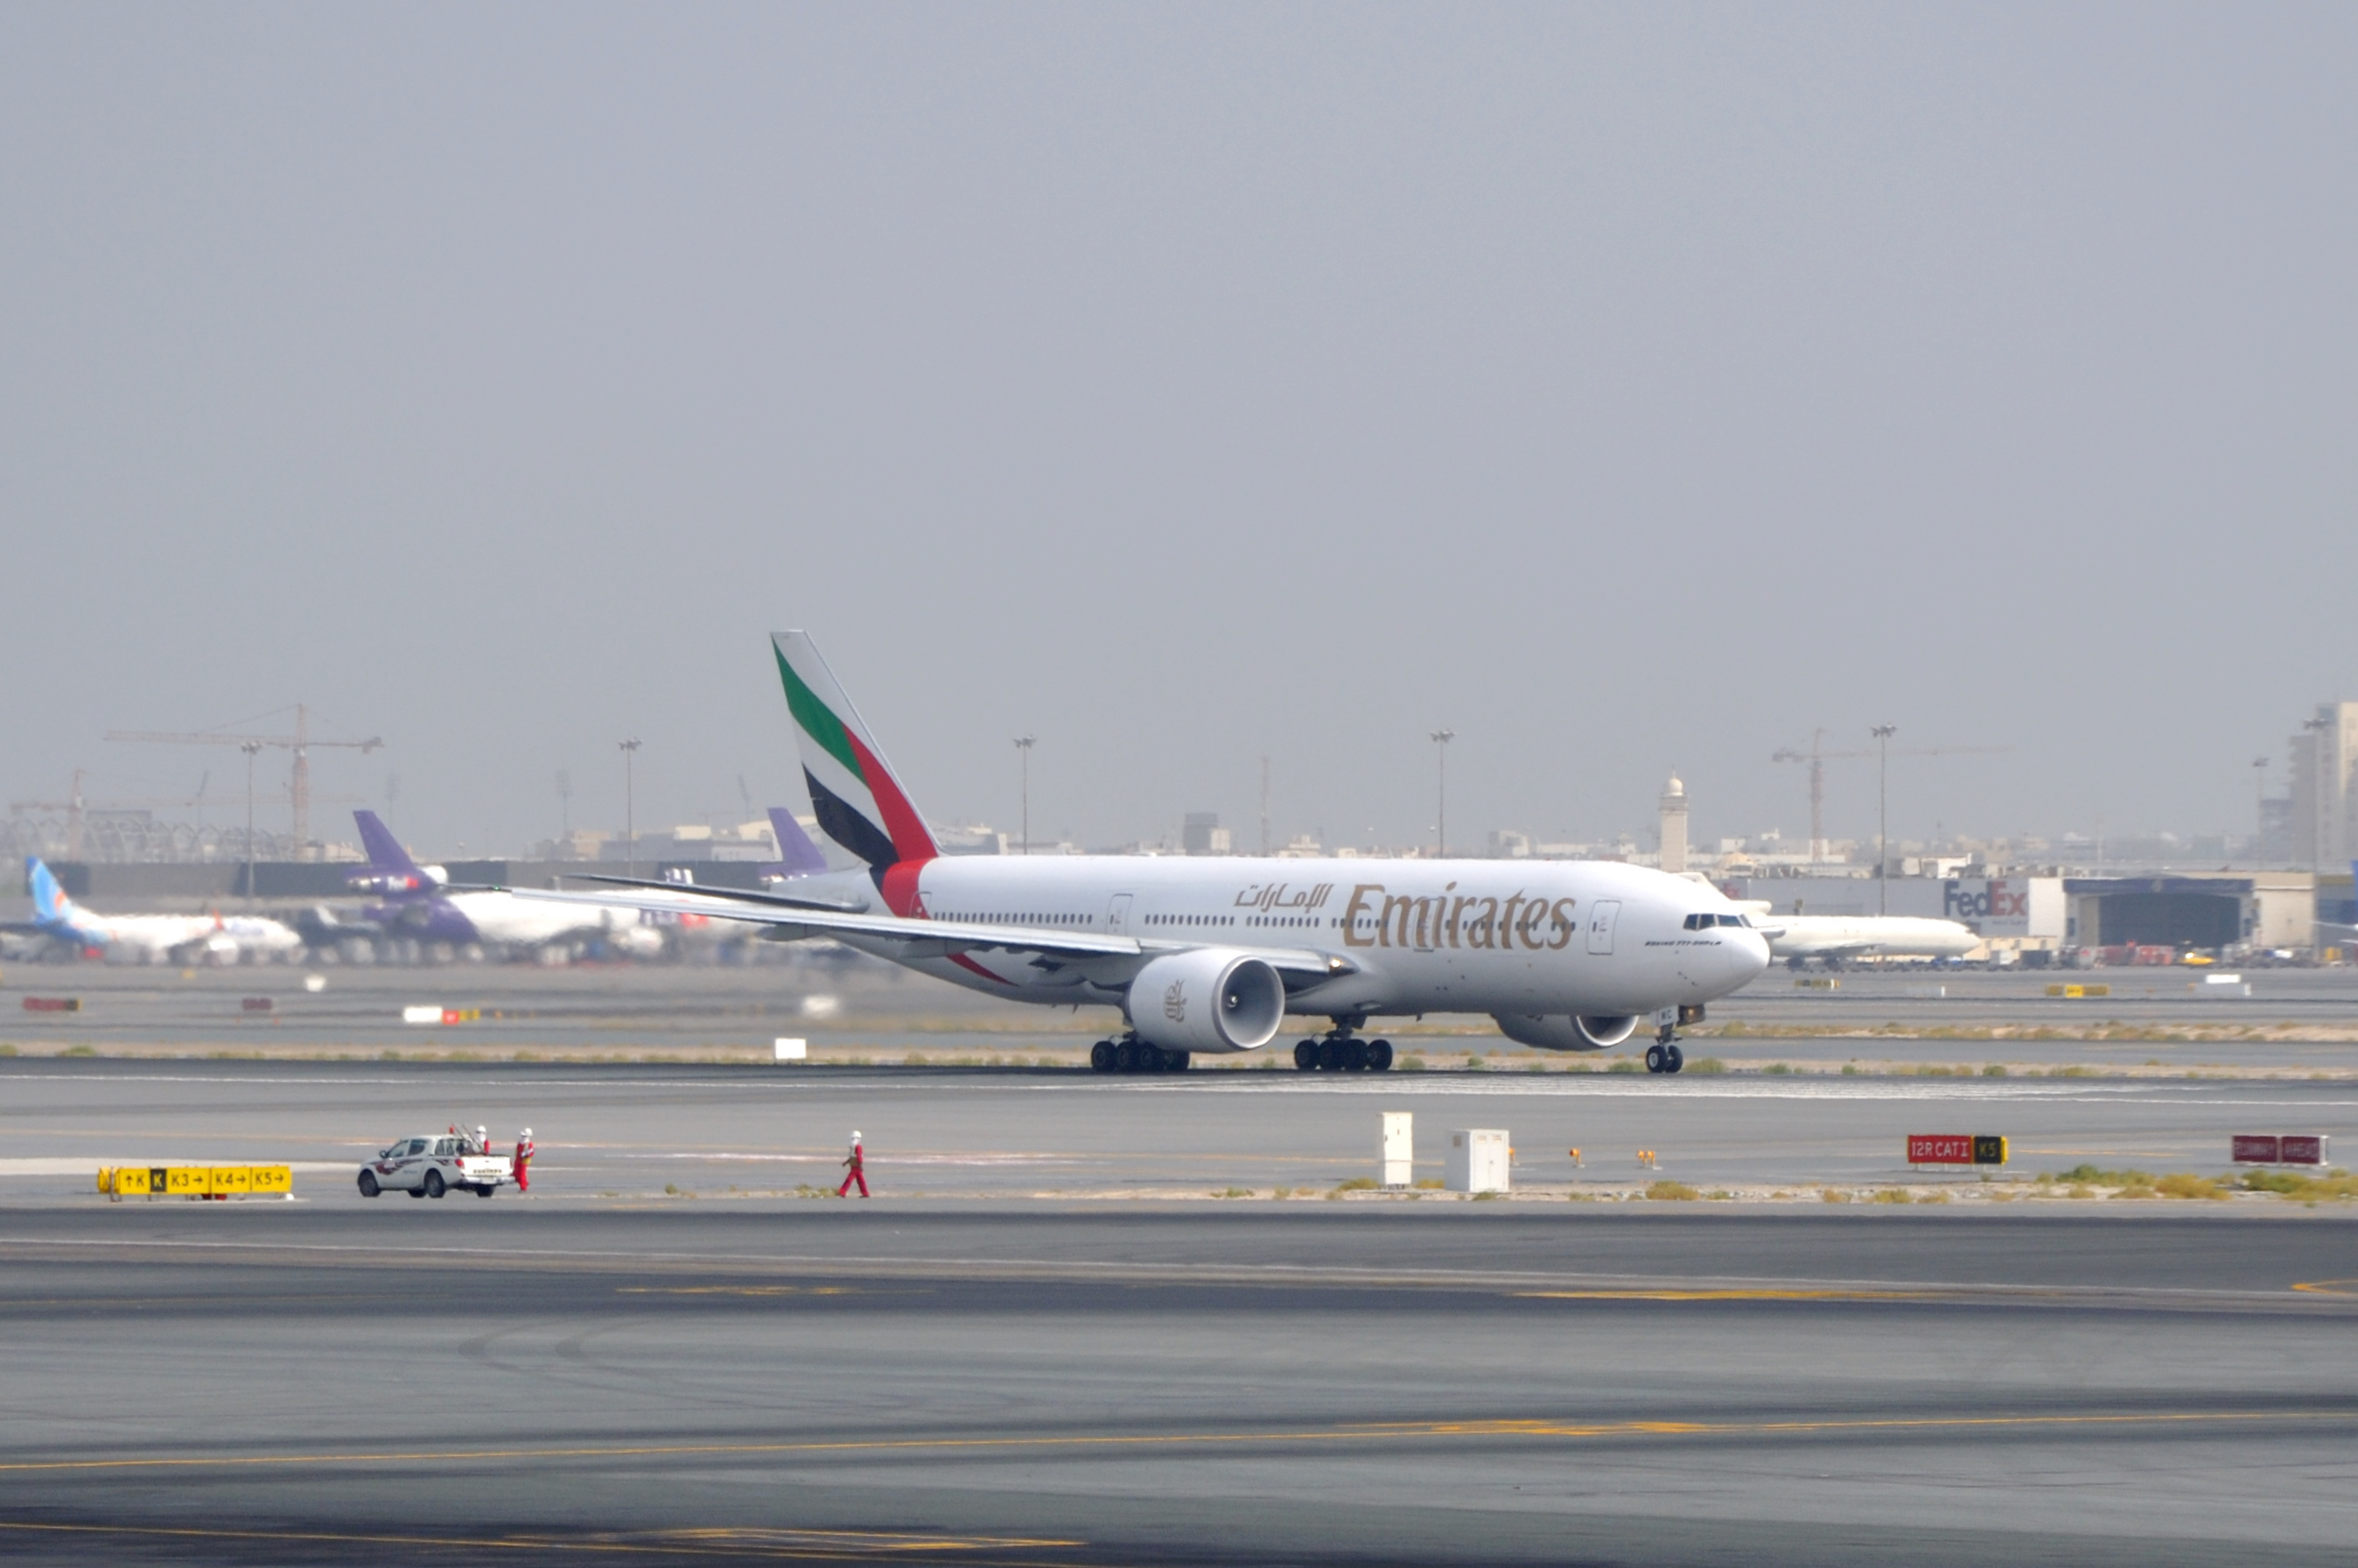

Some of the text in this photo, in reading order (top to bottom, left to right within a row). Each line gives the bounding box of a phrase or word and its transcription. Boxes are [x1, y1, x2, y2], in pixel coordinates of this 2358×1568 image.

[1944, 880, 2027, 918] FedEx
[1343, 881, 1576, 950] Emirates
[1911, 1141, 1933, 1157] 12R
[1979, 1142, 1996, 1158] K5
[136, 1174, 145, 1186] K
[153, 1172, 164, 1187] K
[171, 1174, 189, 1186] K3
[215, 1172, 234, 1186] K4
[255, 1172, 273, 1186] K5
